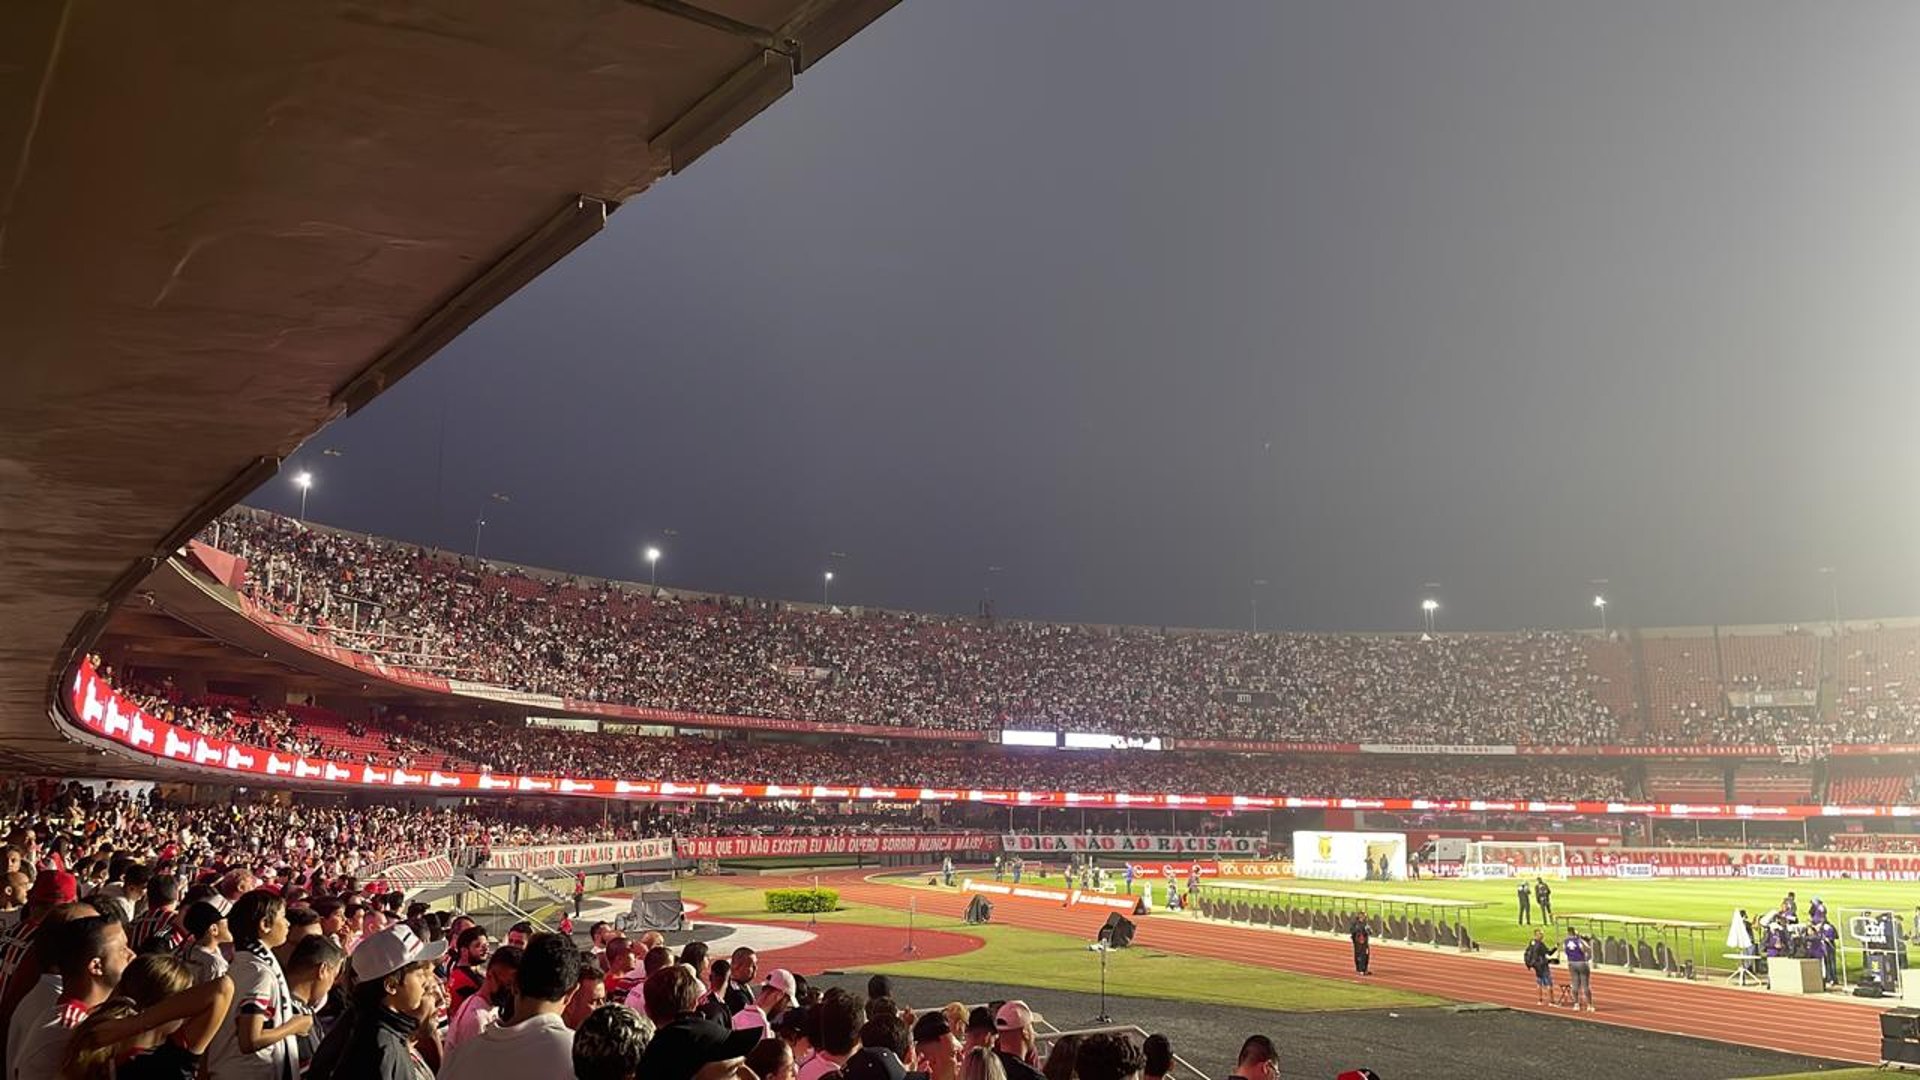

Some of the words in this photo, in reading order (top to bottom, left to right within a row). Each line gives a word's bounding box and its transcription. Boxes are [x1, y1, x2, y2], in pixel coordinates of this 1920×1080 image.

[698, 840, 713, 855] DIA
[715, 840, 733, 857] QUE
[735, 839, 748, 854] TU
[749, 836, 769, 853] NÃO
[772, 838, 808, 853] EXISTIR
[809, 838, 823, 853] EU
[824, 835, 846, 852] NÃO
[881, 837, 916, 851] SORRIR
[918, 836, 952, 851] NUNCA
[1019, 836, 1068, 850] DIGA
[1073, 835, 1115, 850] NÃO
[1123, 837, 1150, 850] AO
[1158, 837, 1250, 851] RACISMO
[557, 849, 578, 865] QUE
[579, 846, 613, 863] JAMAIS
[1223, 863, 1241, 876] GOL
[1243, 864, 1261, 876] GOL
[1263, 864, 1280, 876] GOL
[1282, 864, 1297, 876] GO
